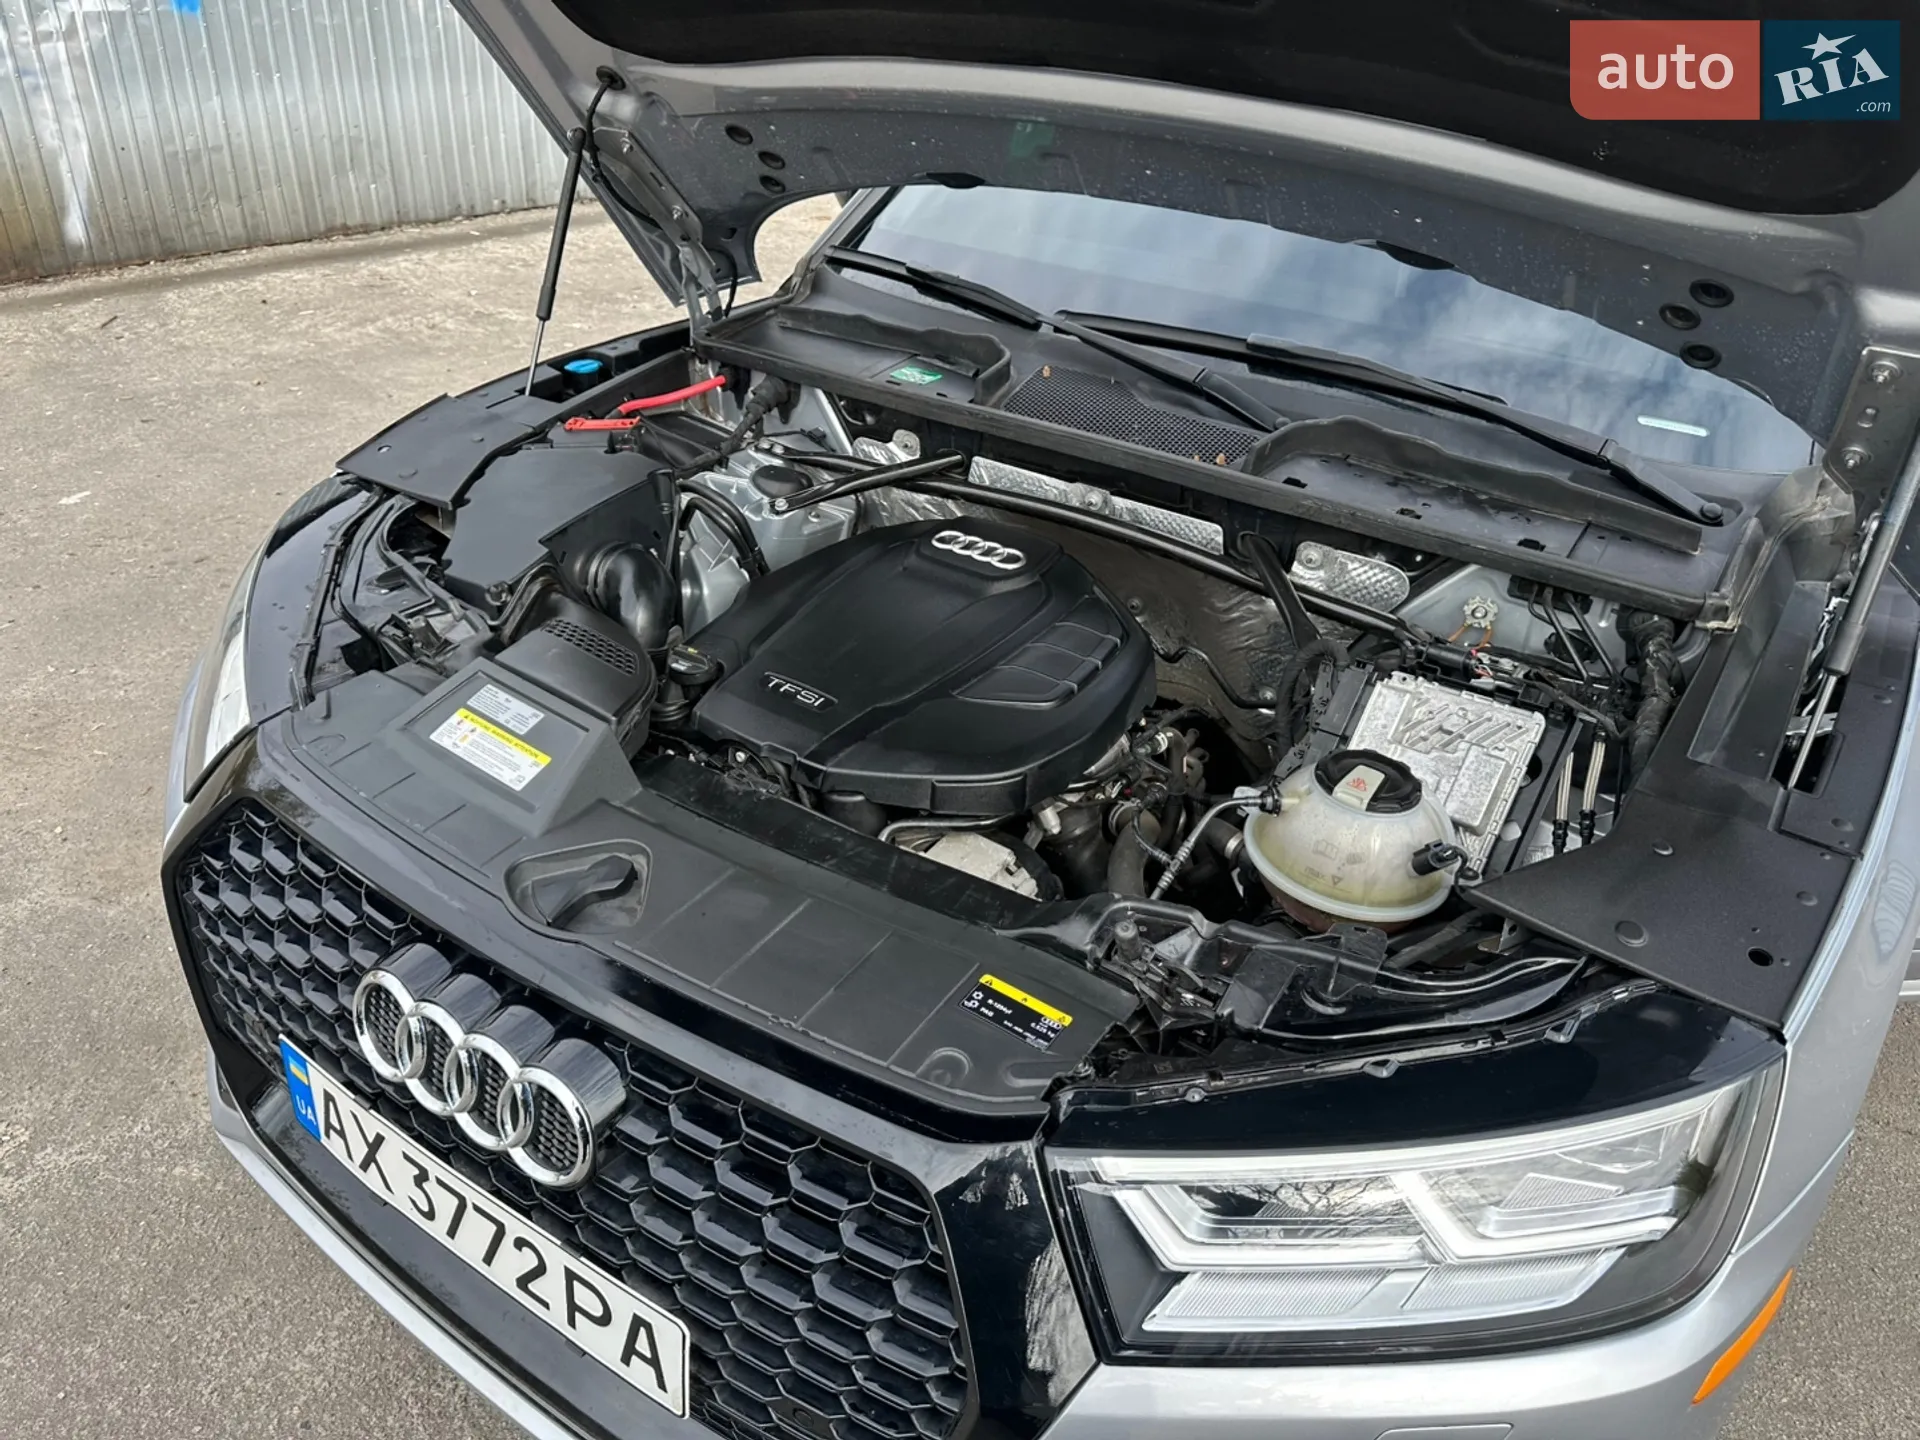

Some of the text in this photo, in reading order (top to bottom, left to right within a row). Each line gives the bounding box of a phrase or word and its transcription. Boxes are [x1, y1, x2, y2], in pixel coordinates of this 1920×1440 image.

[768, 676, 825, 705] TFSI
[296, 1094, 317, 1127] UA
[322, 1087, 669, 1394] AX 3772 PA
